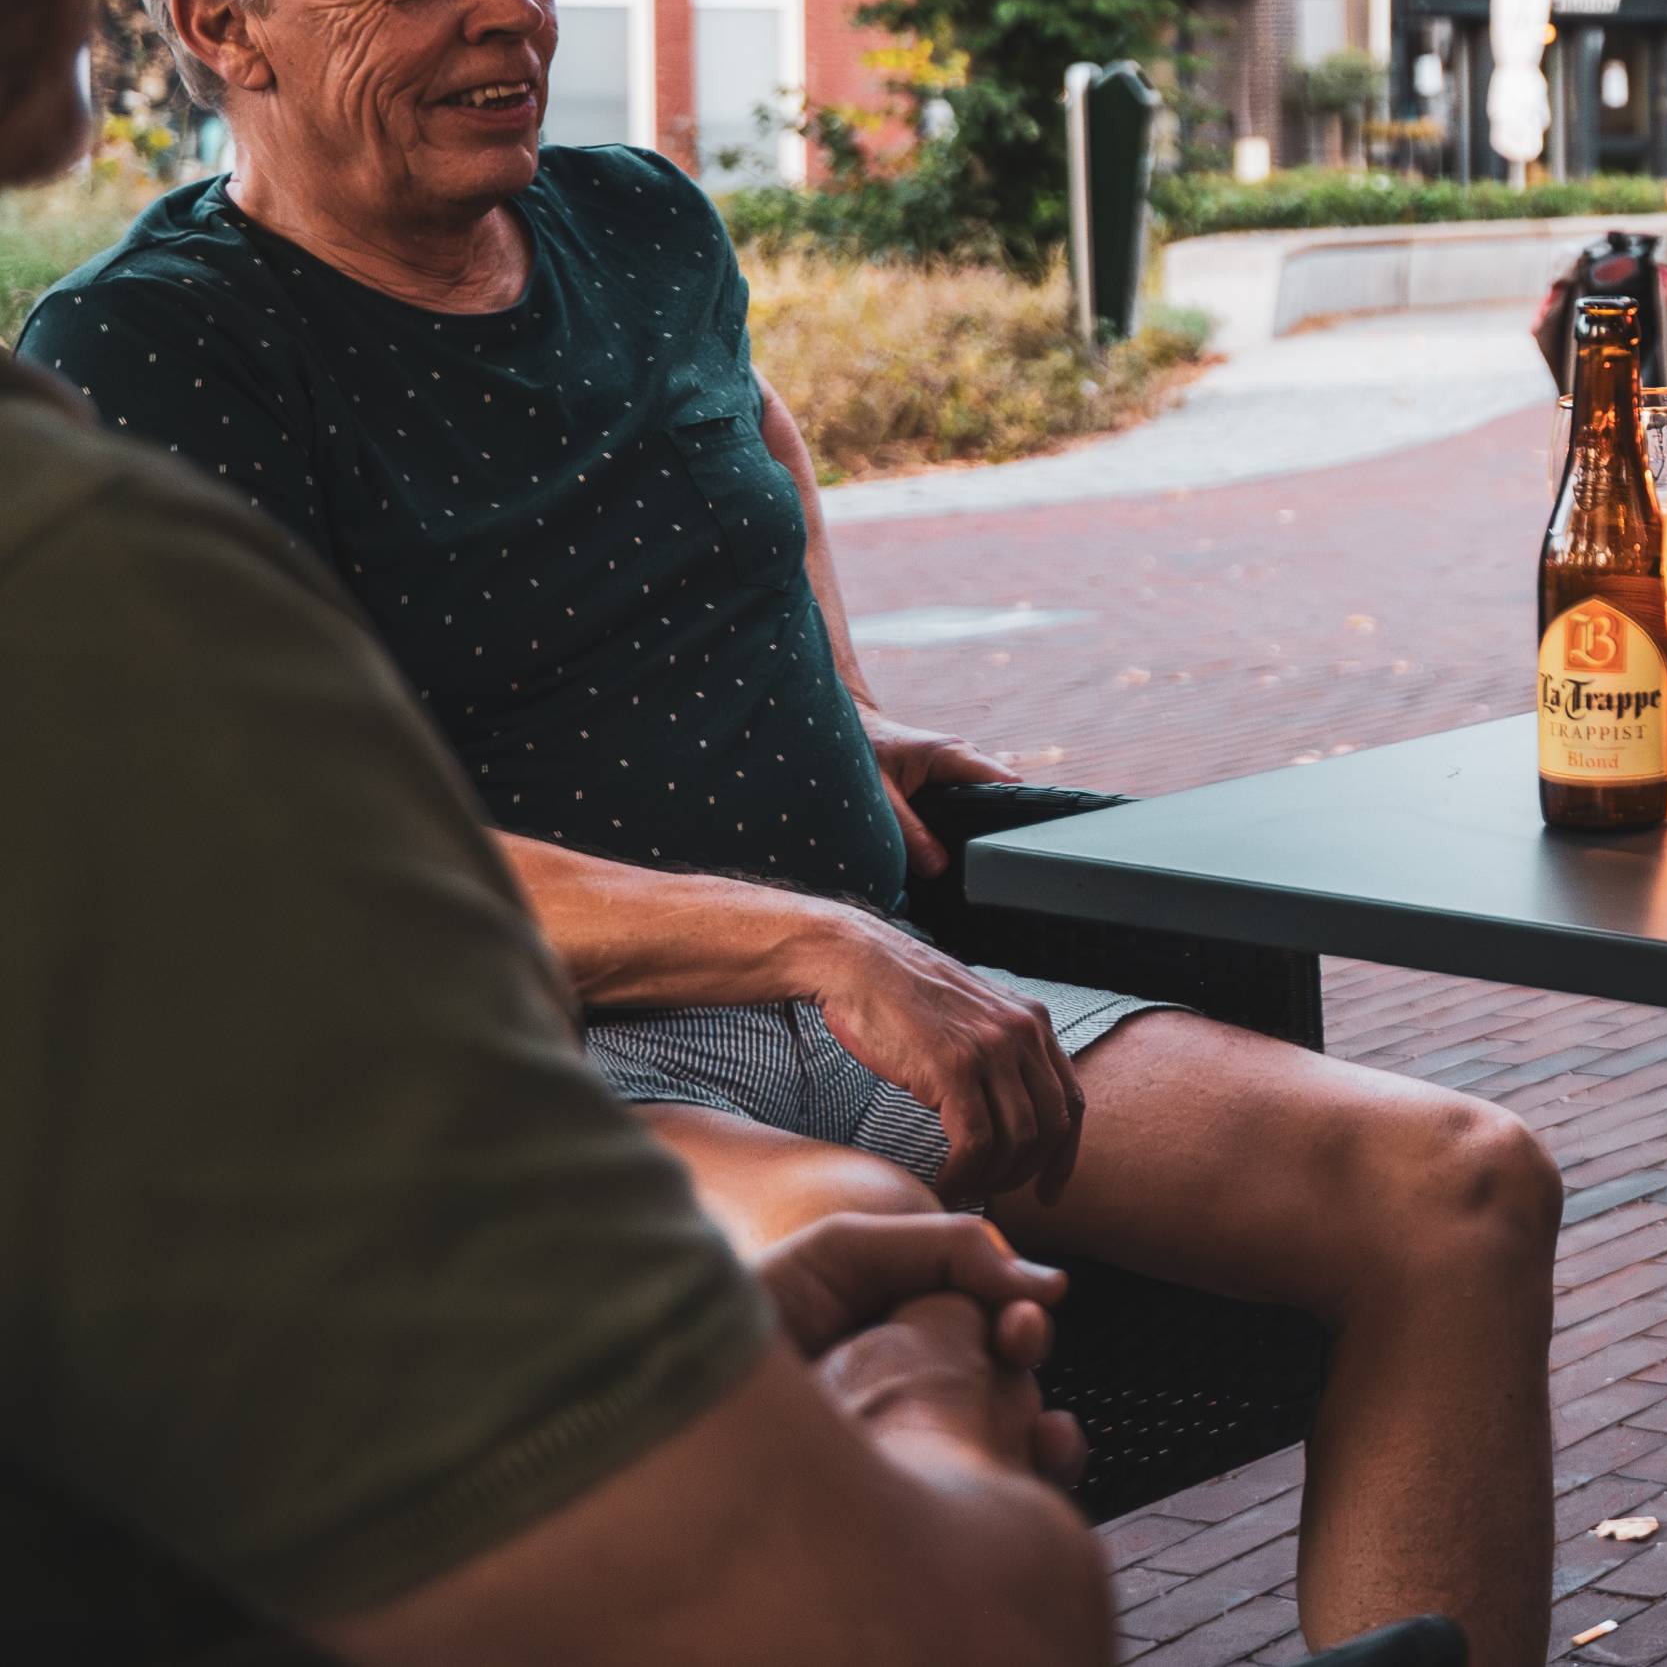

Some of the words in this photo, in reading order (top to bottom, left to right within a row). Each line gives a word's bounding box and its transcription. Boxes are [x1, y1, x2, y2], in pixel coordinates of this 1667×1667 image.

[1540, 672, 1564, 714] La
[1564, 678, 1662, 721] Trappe
[1550, 721, 1647, 741] TRAPPIST
[1567, 751, 1620, 769] Blond
